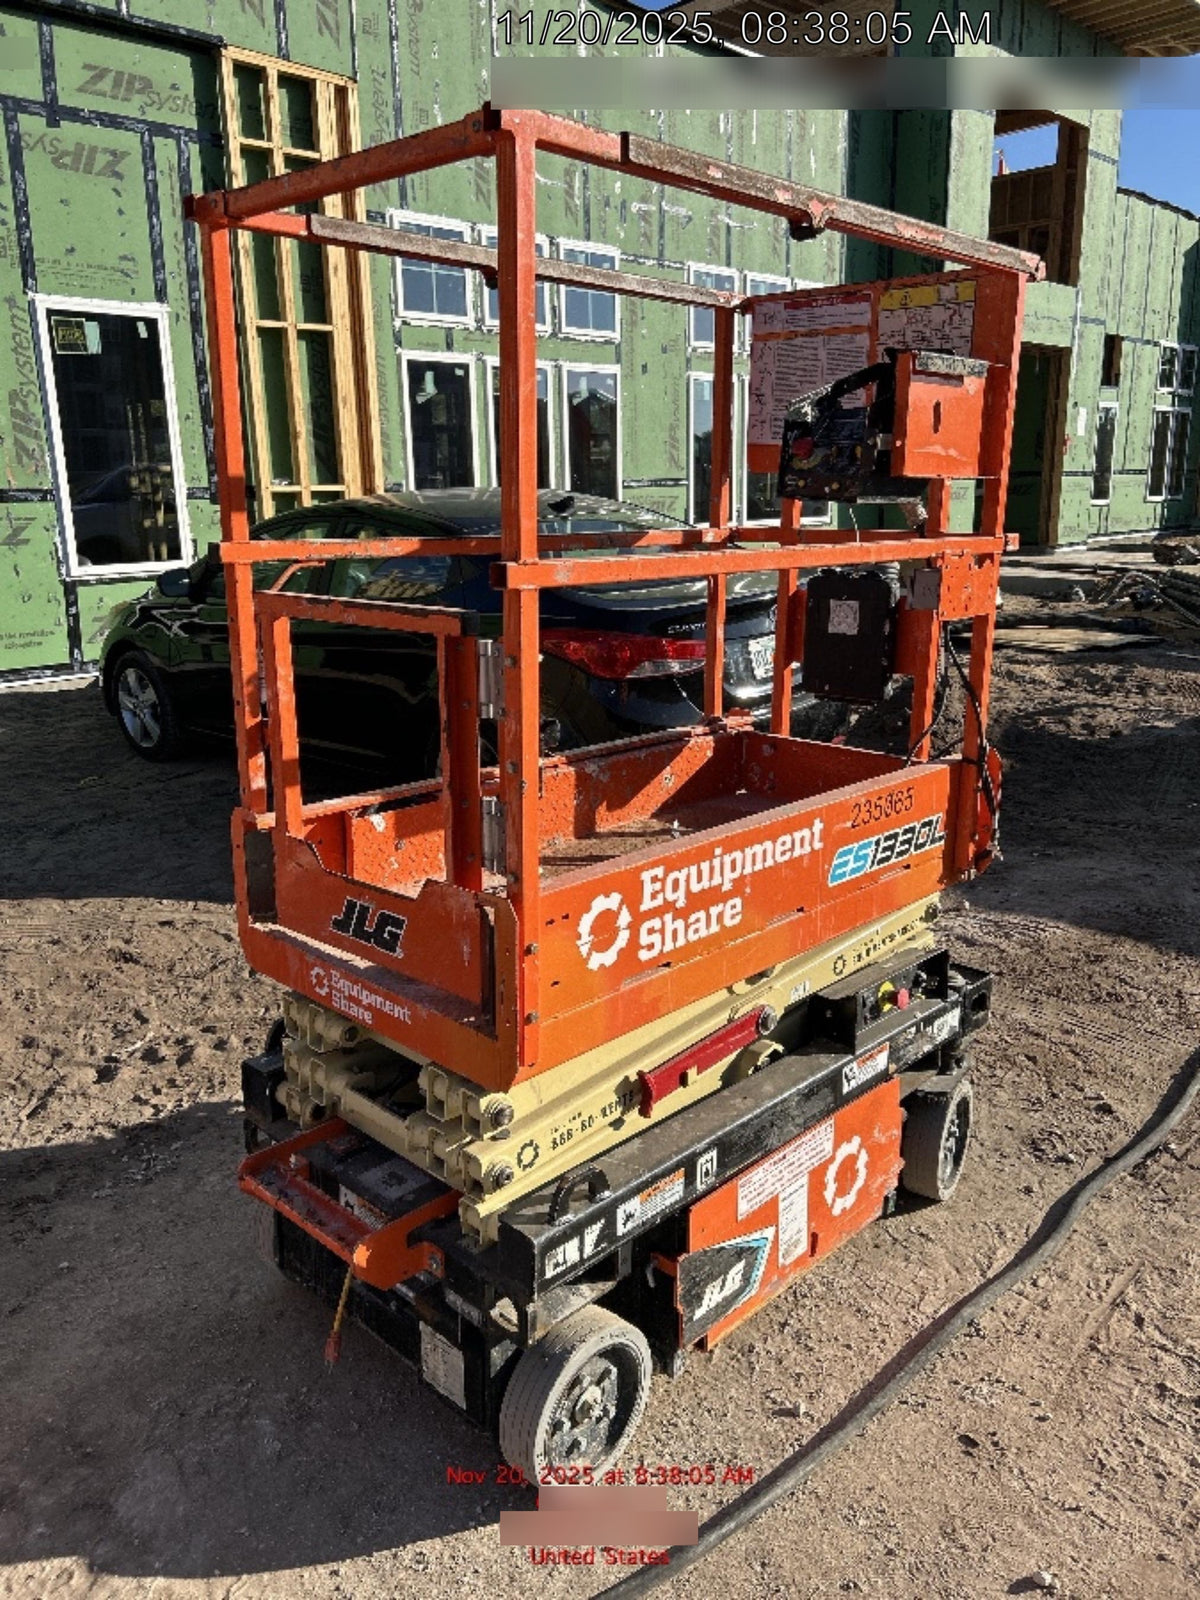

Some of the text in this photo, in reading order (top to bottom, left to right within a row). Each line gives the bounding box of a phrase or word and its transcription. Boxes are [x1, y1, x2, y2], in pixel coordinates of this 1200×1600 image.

[639, 817, 824, 911] Equipment
[828, 812, 946, 886] ES1330L
[330, 896, 408, 958] JLG
[637, 896, 743, 962] Share
[330, 969, 412, 1025] Equipment
[331, 990, 373, 1024] Share
